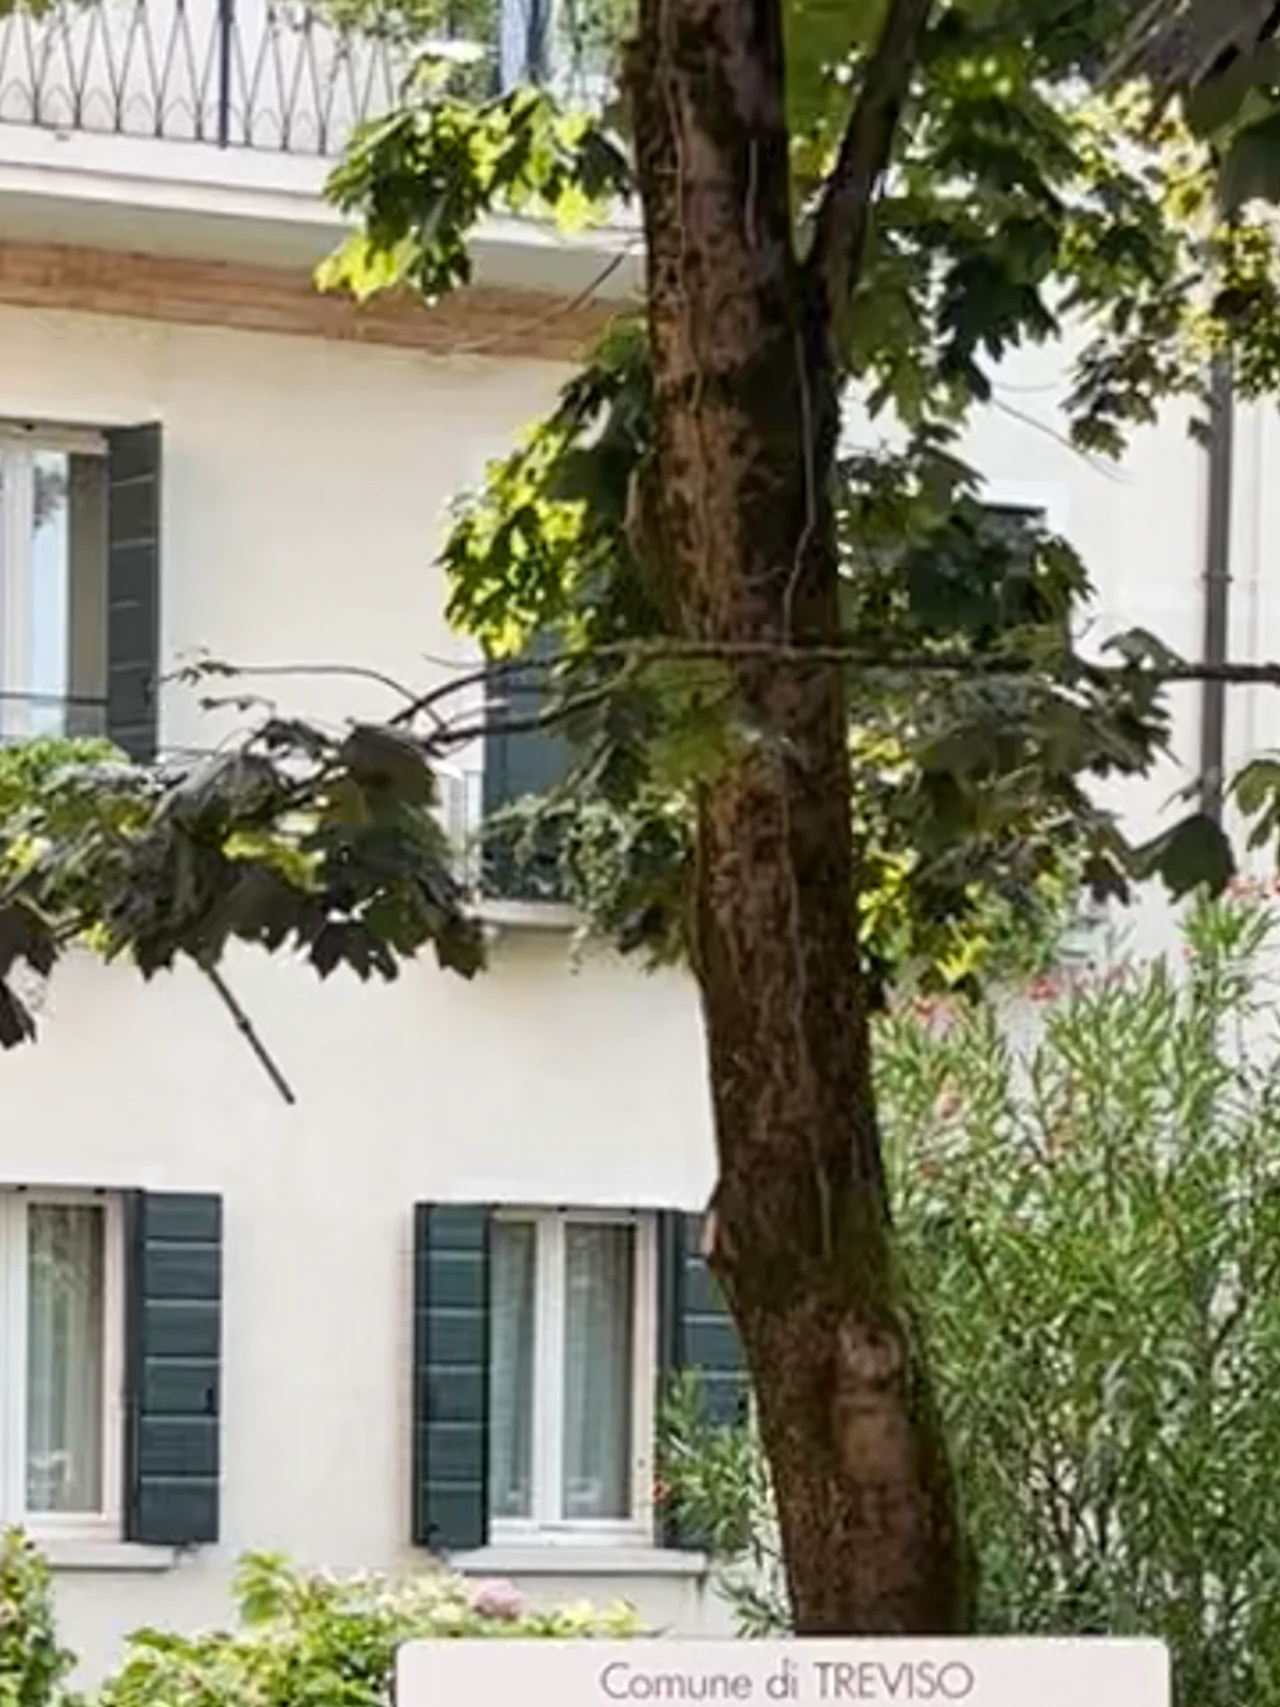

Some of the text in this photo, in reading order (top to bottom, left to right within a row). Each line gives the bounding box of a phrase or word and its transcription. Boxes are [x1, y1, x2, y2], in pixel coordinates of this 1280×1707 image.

[600, 1657, 975, 1700] Comune di TREVISO
